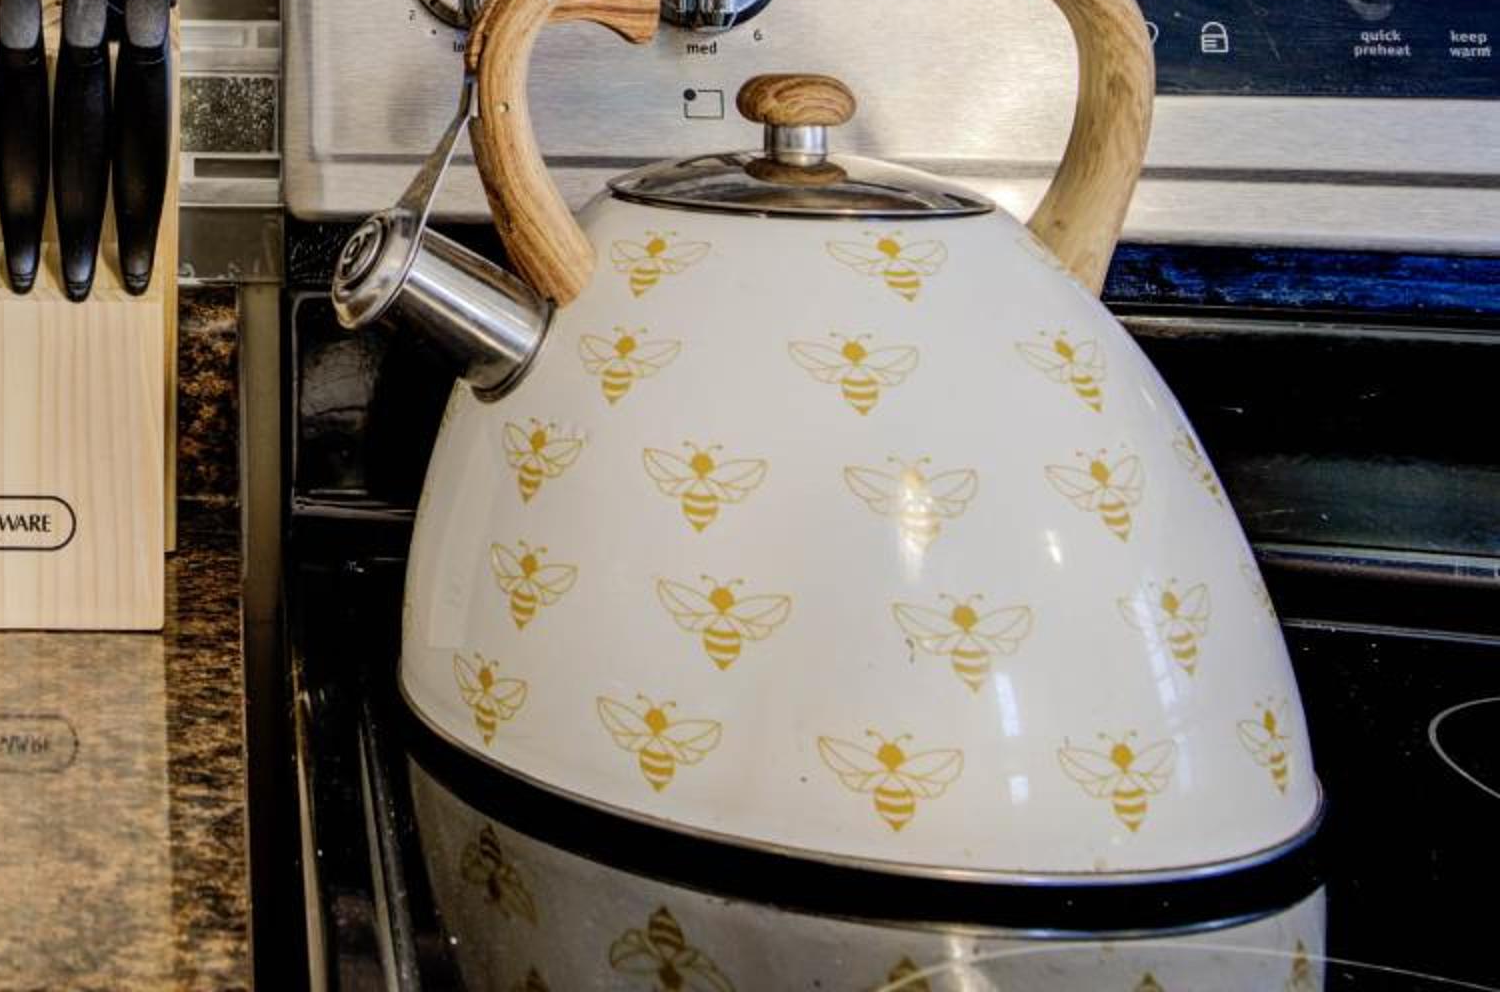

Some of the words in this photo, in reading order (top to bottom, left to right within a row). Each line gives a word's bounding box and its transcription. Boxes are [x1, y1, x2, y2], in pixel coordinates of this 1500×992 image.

[753, 28, 764, 41] 6
[1360, 29, 1401, 43] quick
[1449, 29, 1488, 44] keep
[686, 41, 717, 55] med
[1353, 43, 1412, 58] preheat
[1449, 46, 1492, 58] warm
